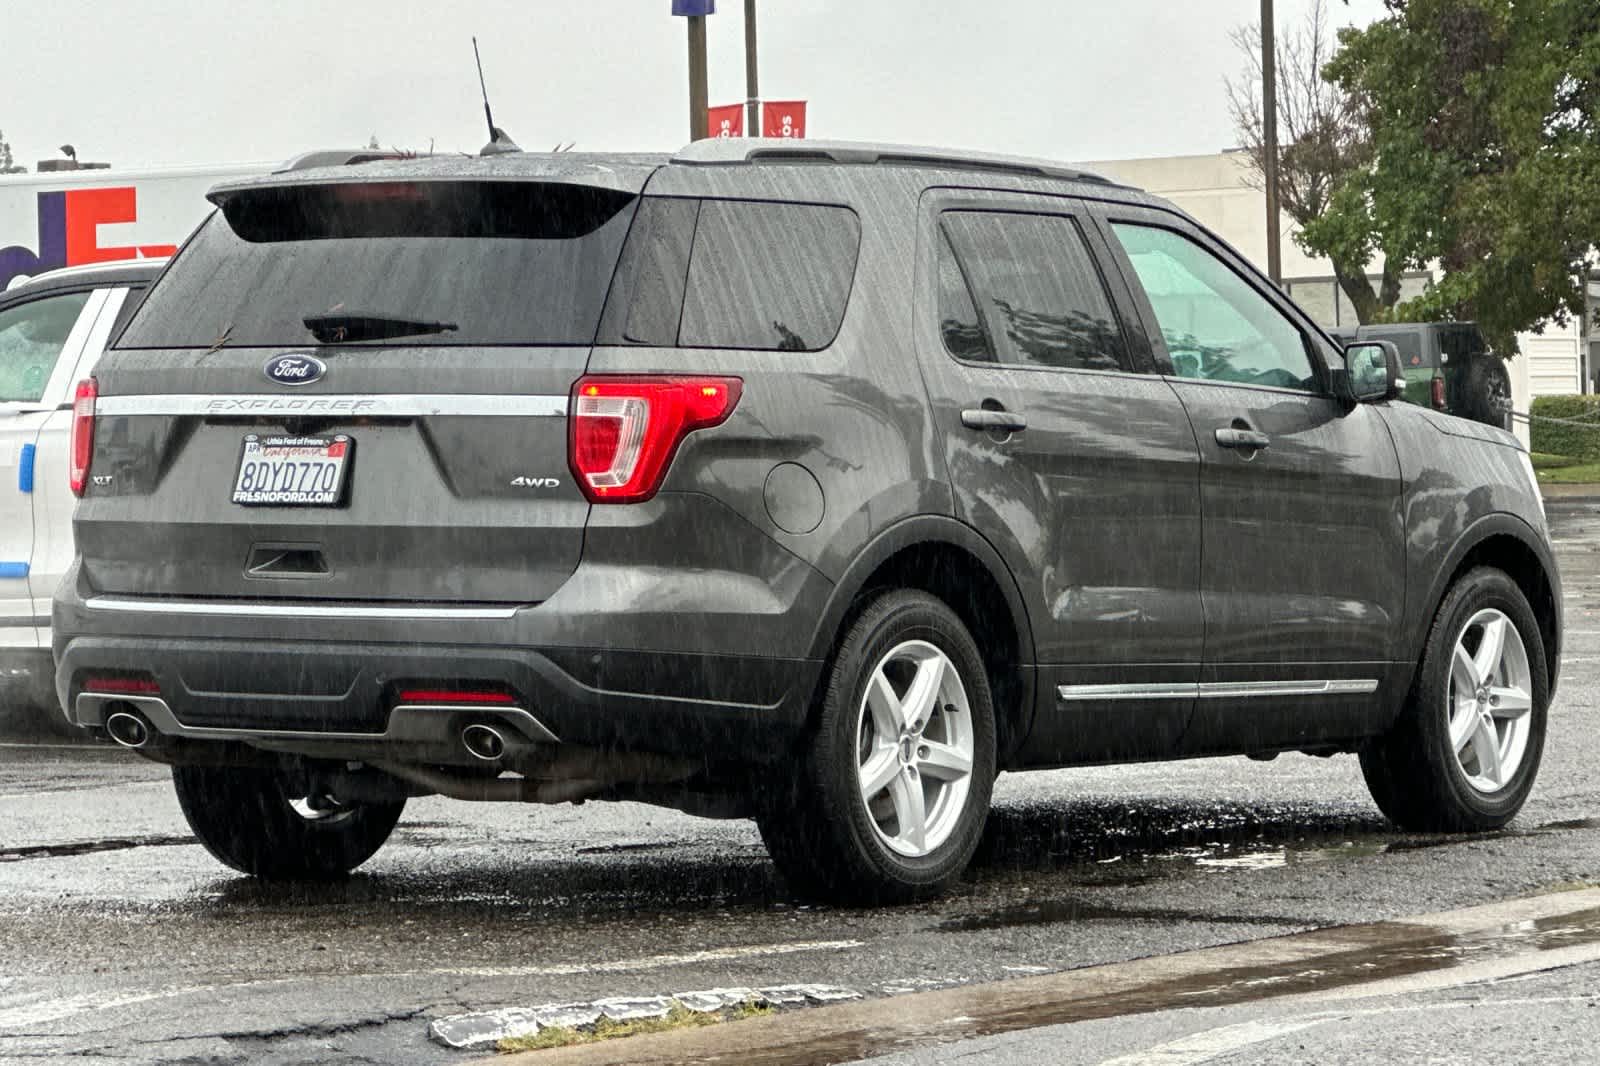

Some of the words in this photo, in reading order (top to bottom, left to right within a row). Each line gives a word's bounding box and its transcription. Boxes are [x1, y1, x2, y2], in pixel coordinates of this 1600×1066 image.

[274, 359, 310, 377] Ford
[206, 399, 376, 411] EXPLORER
[267, 437, 282, 445] Lithia
[283, 437, 296, 445] Ford
[297, 437, 304, 445] of
[304, 437, 323, 445] Fresno
[263, 446, 322, 460] California
[241, 462, 337, 492] 8DYD770
[510, 476, 560, 488] 4WD
[233, 491, 335, 502] FRESNOFORD.COM
